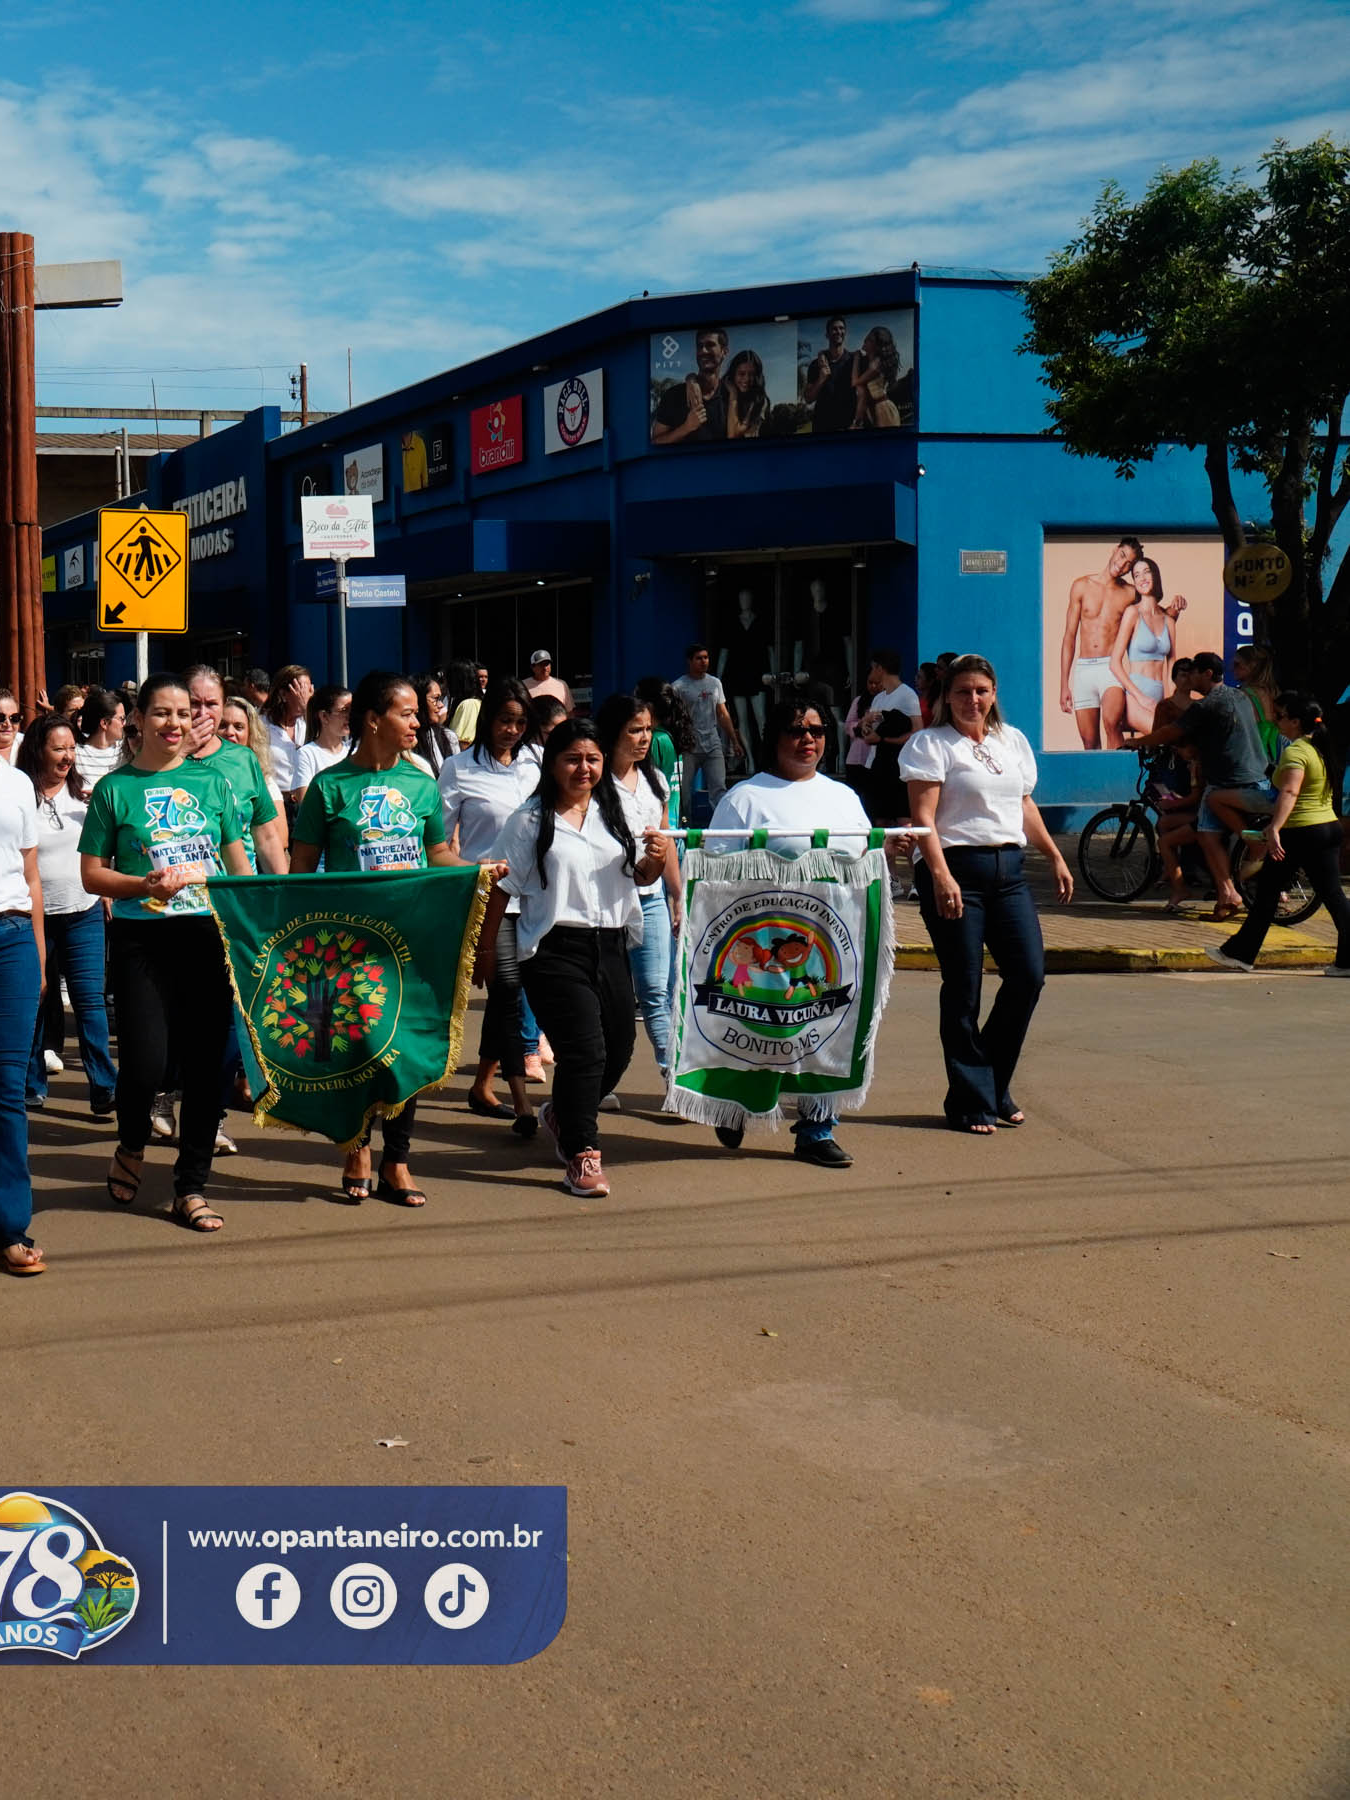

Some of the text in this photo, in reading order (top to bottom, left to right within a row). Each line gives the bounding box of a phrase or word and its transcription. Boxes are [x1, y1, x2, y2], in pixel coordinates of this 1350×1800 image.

[479, 438, 515, 467] brandili
[306, 519, 370, 534] Beco da Arte
[191, 528, 233, 561] MODAS
[1234, 556, 1285, 572] PONTO
[361, 843, 405, 856] NATUREZA
[703, 896, 850, 955] CENTRO DE EDUCAÇÃO INFANTIL
[251, 911, 413, 979] CENTRO DE EDUCAÇÃO INFANTIL
[715, 996, 832, 1023] LAURA VICUÑA
[722, 1026, 820, 1056] BONITO-MS
[297, 1078, 354, 1092] TEIXEIRA
[353, 1048, 401, 1084] SIQUIRA
